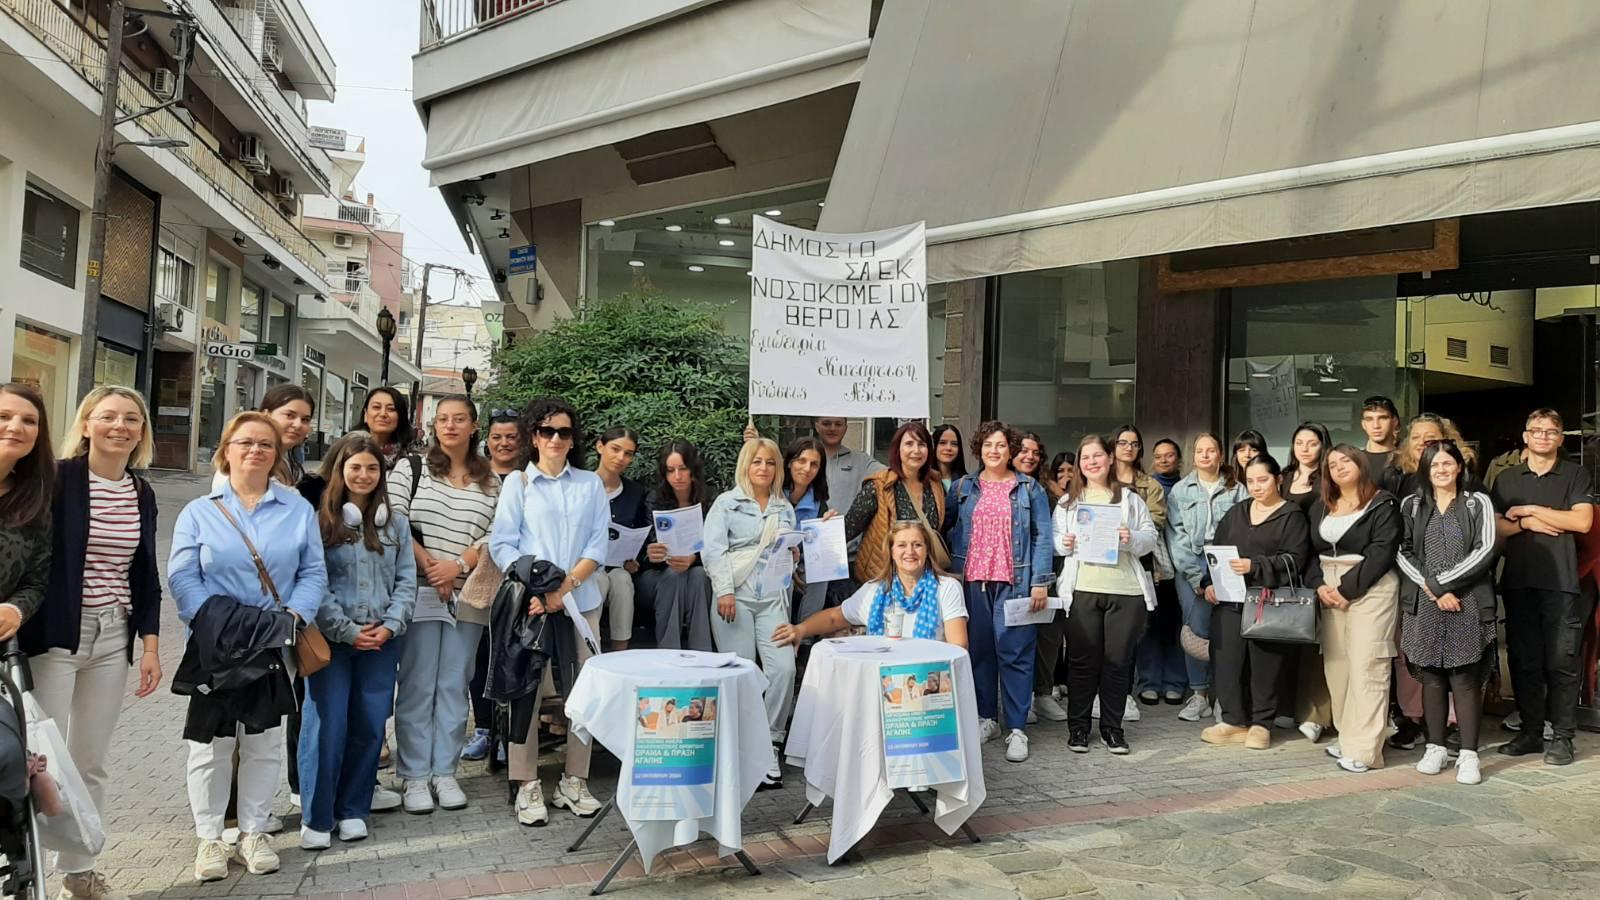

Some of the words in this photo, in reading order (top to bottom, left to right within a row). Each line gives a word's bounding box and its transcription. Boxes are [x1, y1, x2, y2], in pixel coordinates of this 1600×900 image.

[754, 228, 875, 258] ΔΗΜΟΣΙΟ
[845, 258, 913, 281] ΣΑΕΚ
[753, 277, 928, 305] ΝΟΣΟΚΟΜΕΙΟΥ
[786, 305, 901, 330] ΒΕΡΟΙΑΣ
